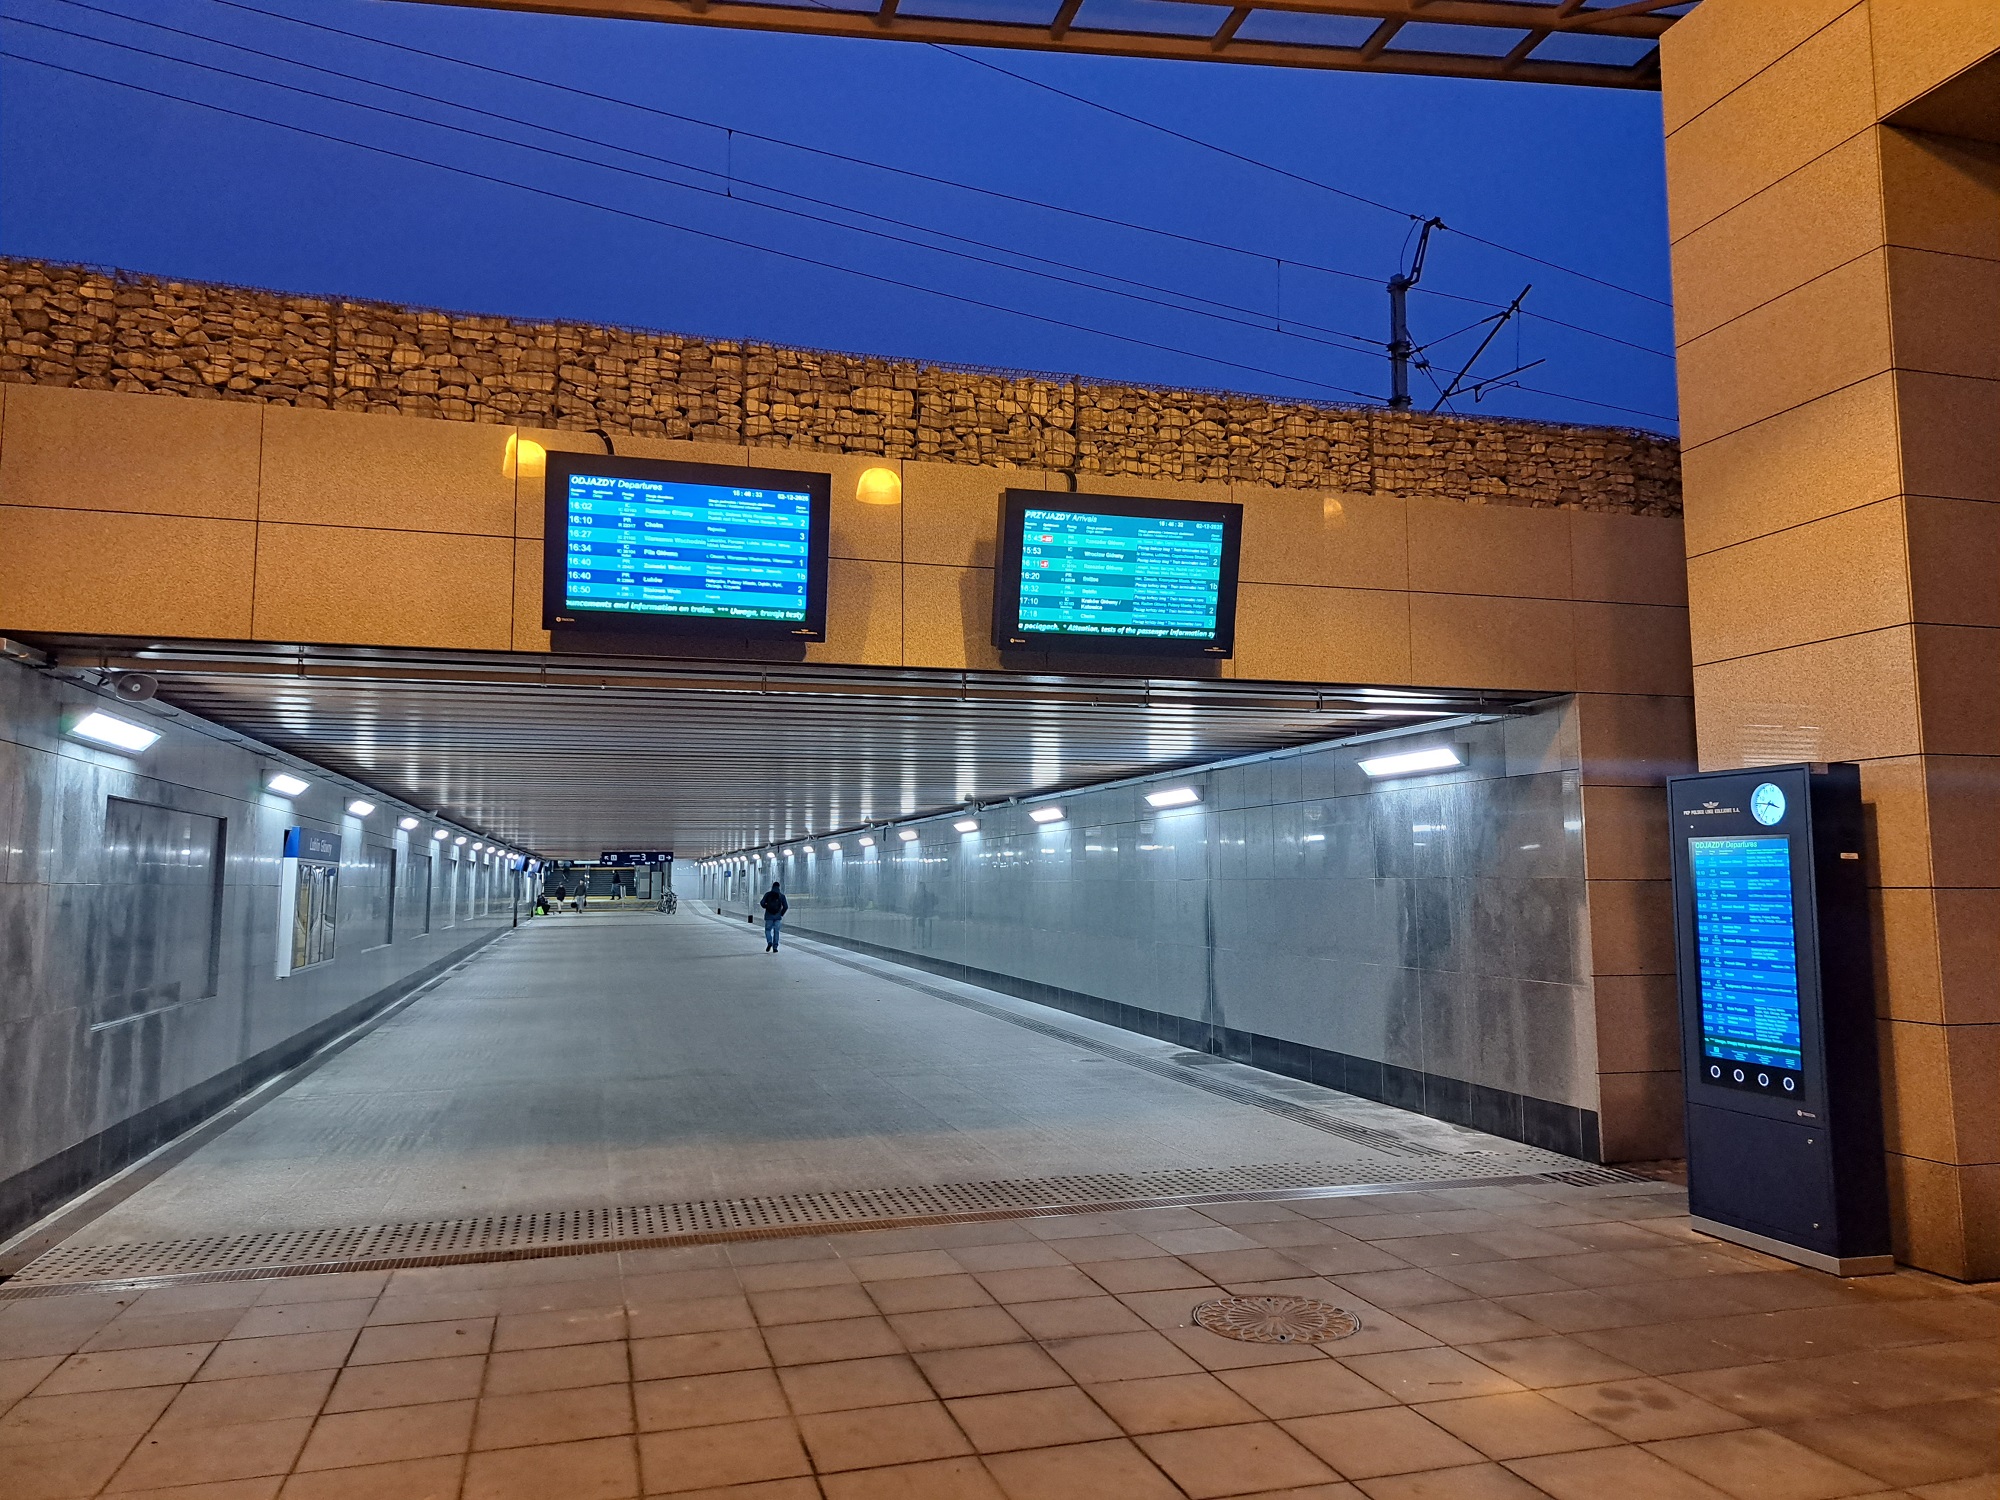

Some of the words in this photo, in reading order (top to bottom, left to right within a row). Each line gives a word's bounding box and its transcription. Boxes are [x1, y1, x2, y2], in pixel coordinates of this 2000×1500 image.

[570, 476, 616, 487] ODJAZDY
[618, 479, 663, 491] Departures
[1024, 511, 1071, 521] PRZYJAZDY
[1072, 514, 1097, 523] Arrivals
[630, 602, 677, 611] information
